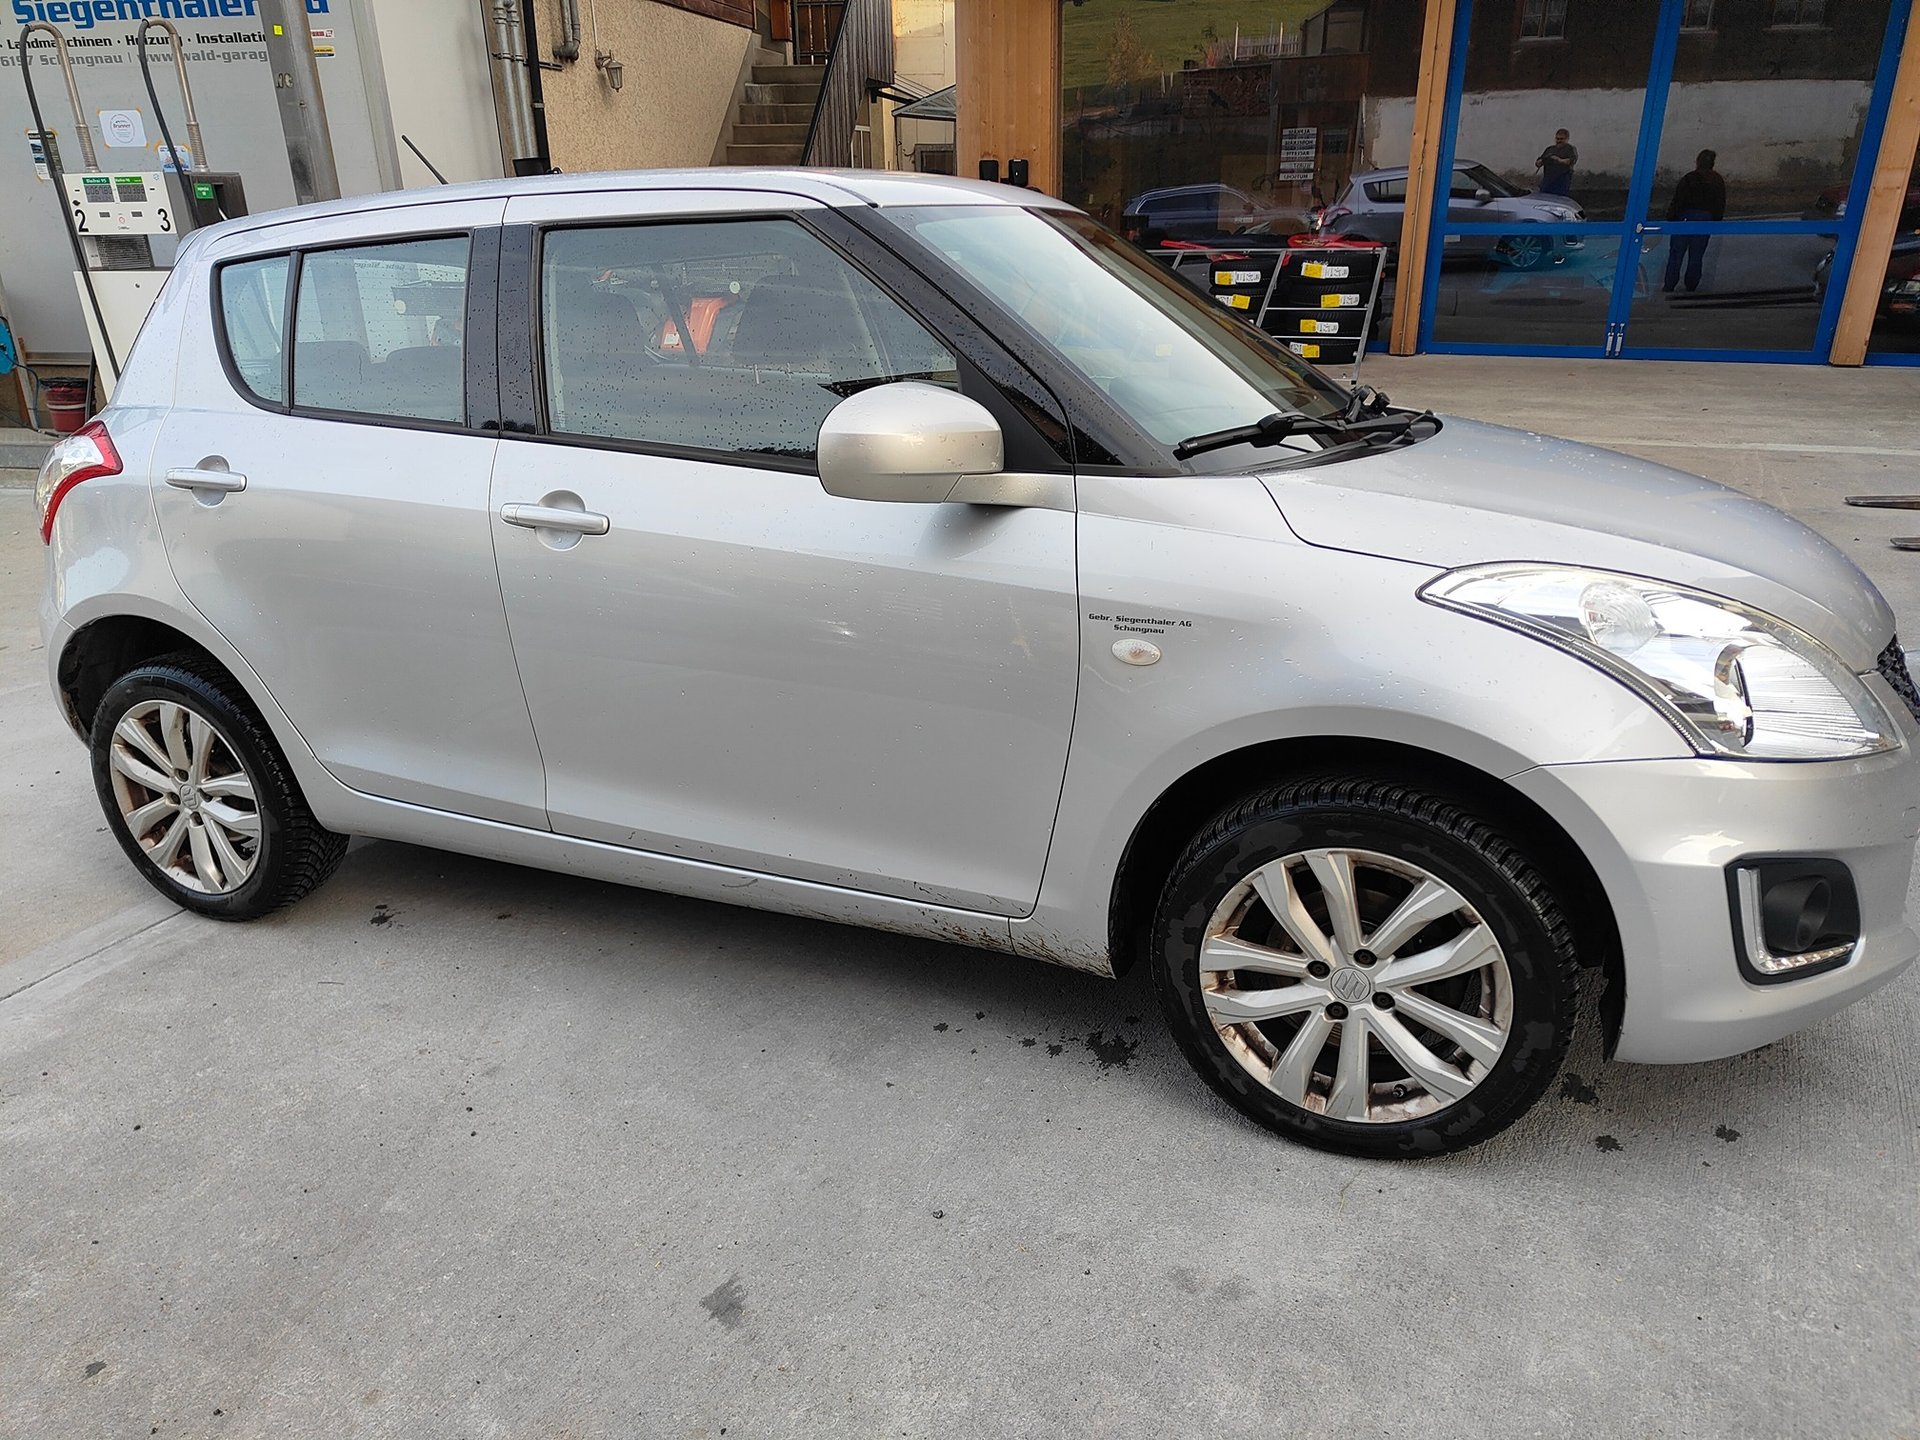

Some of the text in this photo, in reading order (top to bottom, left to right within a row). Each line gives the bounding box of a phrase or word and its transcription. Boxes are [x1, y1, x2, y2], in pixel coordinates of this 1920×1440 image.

[12, 0, 257, 29] Siegenthaler
[7, 36, 111, 49] Landmachinen
[196, 31, 267, 44] Installati
[74, 209, 89, 232] 2
[157, 208, 171, 232] 3
[1088, 613, 1192, 628] Gebr. Siegenthaler AG
[1113, 624, 1165, 634] Schangnau
